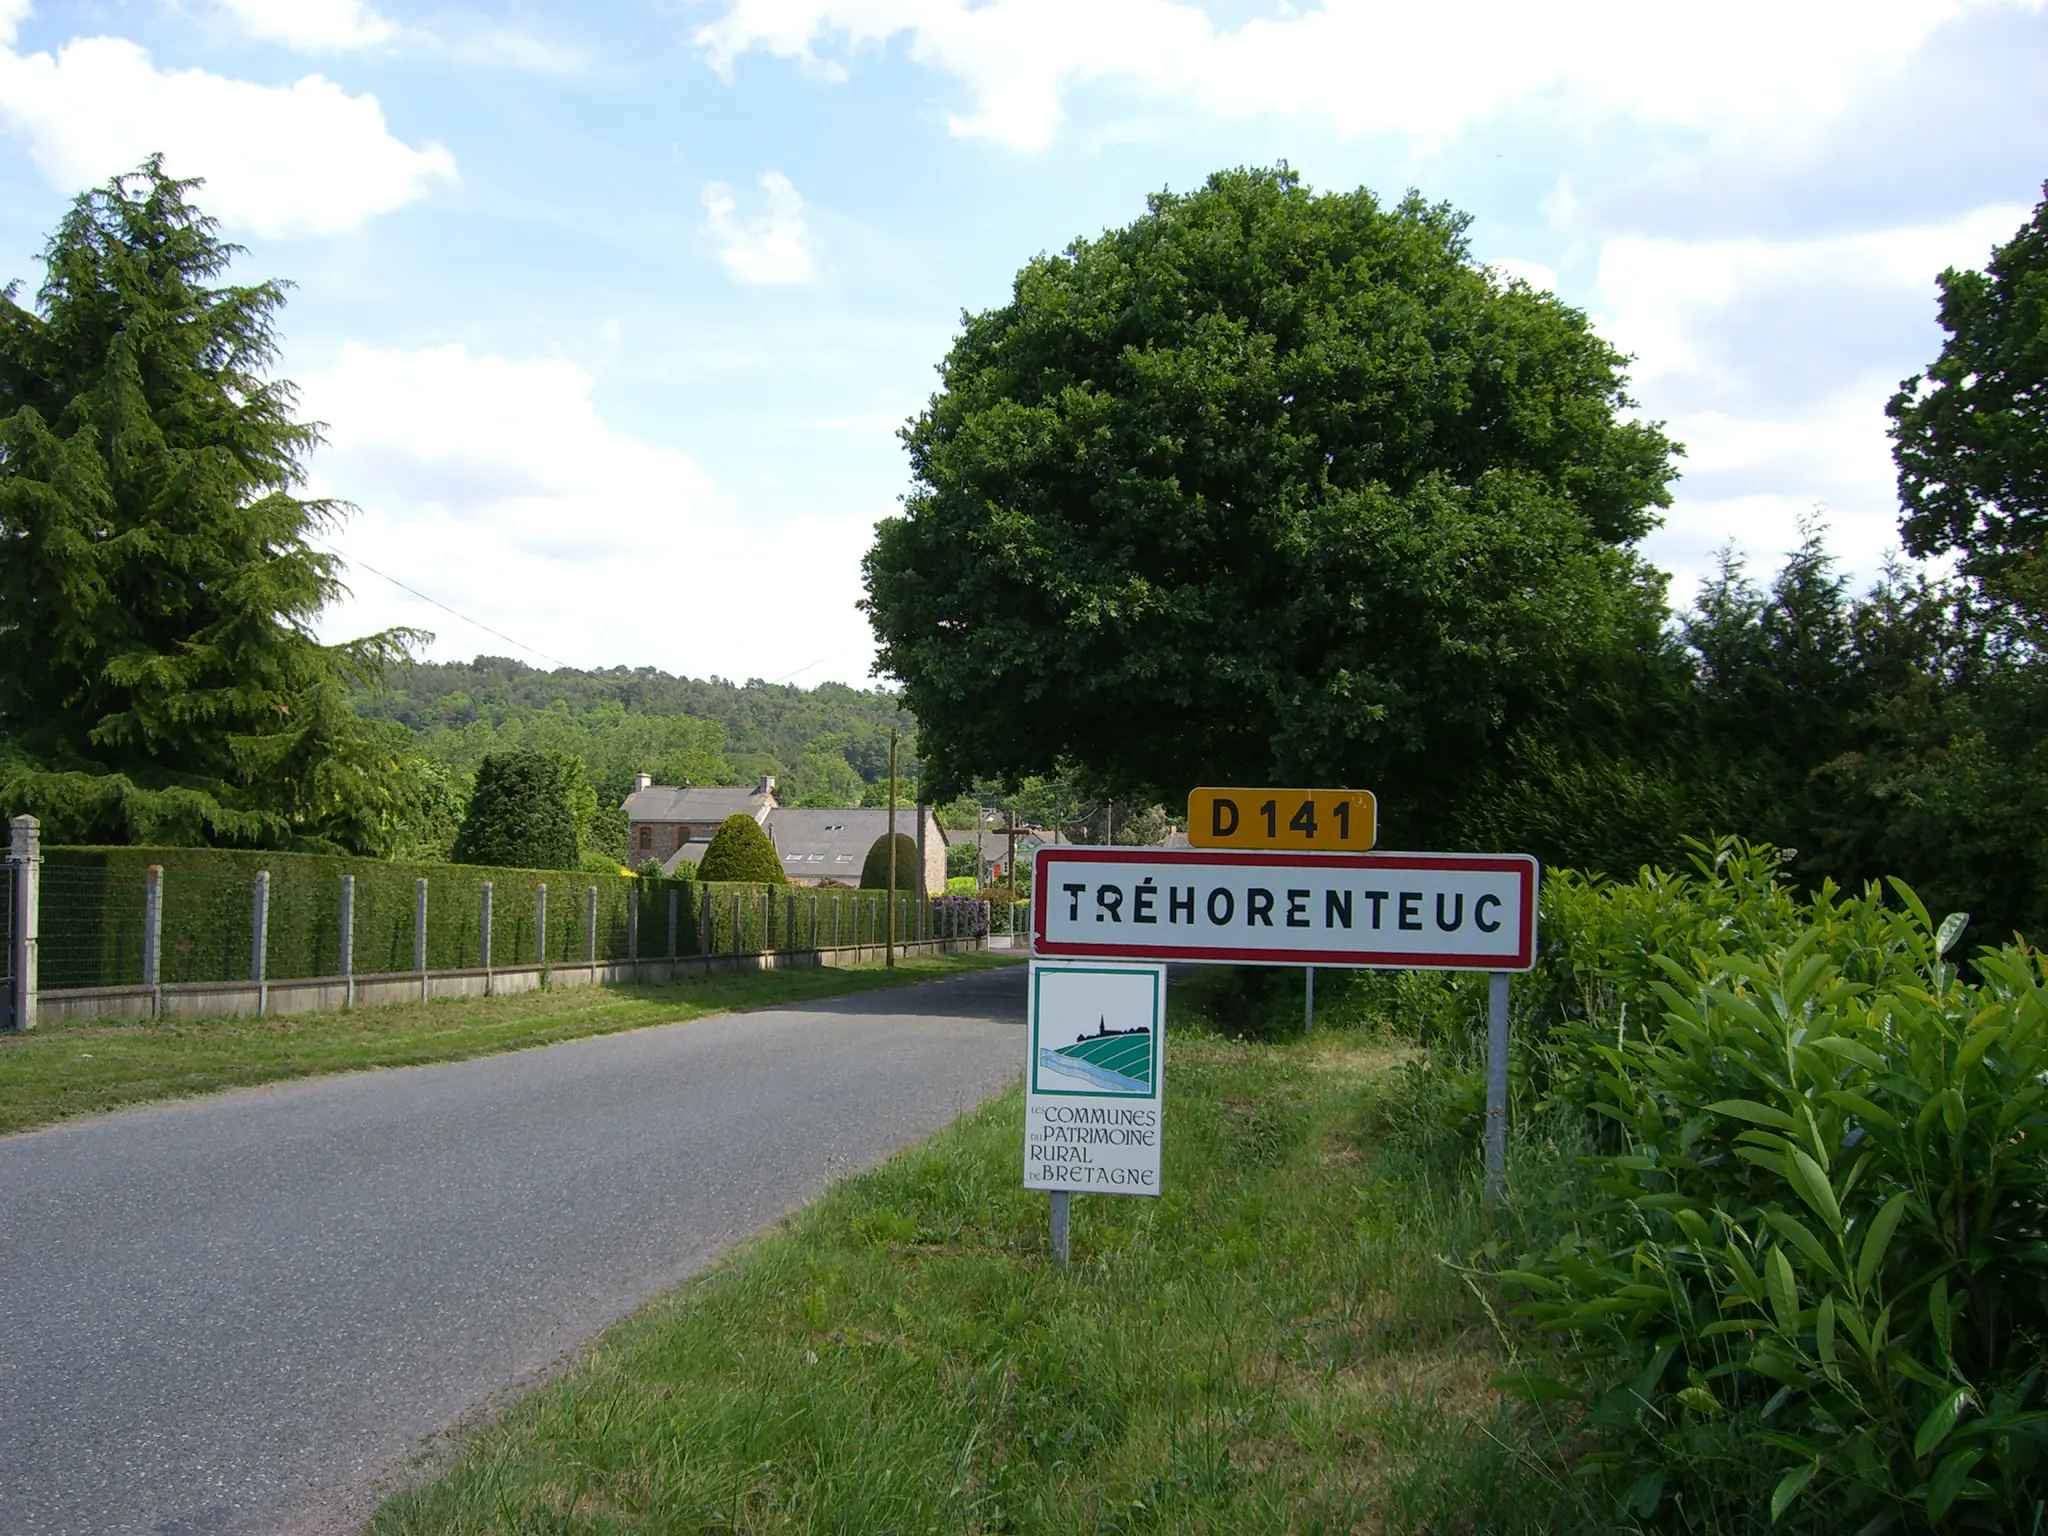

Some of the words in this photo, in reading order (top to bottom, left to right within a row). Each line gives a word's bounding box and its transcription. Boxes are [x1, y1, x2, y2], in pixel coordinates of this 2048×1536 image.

[1212, 798, 1239, 838] D
[1260, 800, 1350, 840] 141
[1062, 877, 1502, 933] TRÉHORENTEUC
[1044, 1106, 1156, 1127] COMMUNES
[1043, 1126, 1155, 1147] PATRIMOINE
[1030, 1144, 1093, 1164] RURAL
[1042, 1164, 1154, 1186] BRETAGNE
